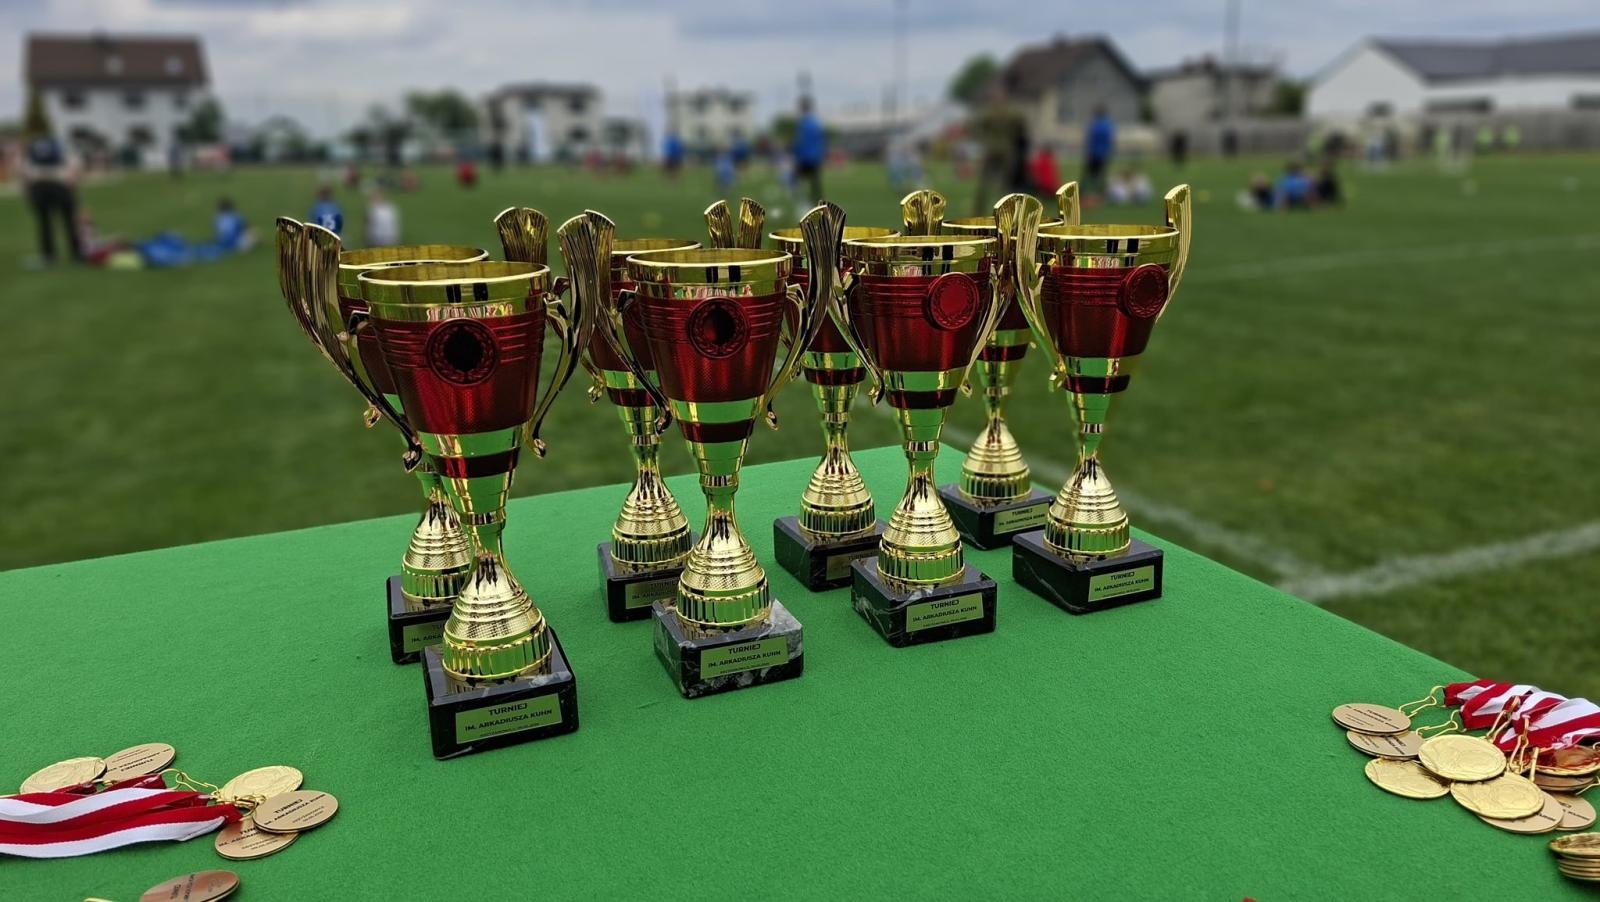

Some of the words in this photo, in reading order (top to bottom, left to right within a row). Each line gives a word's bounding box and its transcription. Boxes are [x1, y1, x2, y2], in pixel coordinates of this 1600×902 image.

[931, 600, 960, 609] TURNIEJ
[728, 643, 761, 654] TURNIEJ
[488, 703, 528, 716] TURNIEJ
[479, 714, 529, 729] ARKADIUSZA
